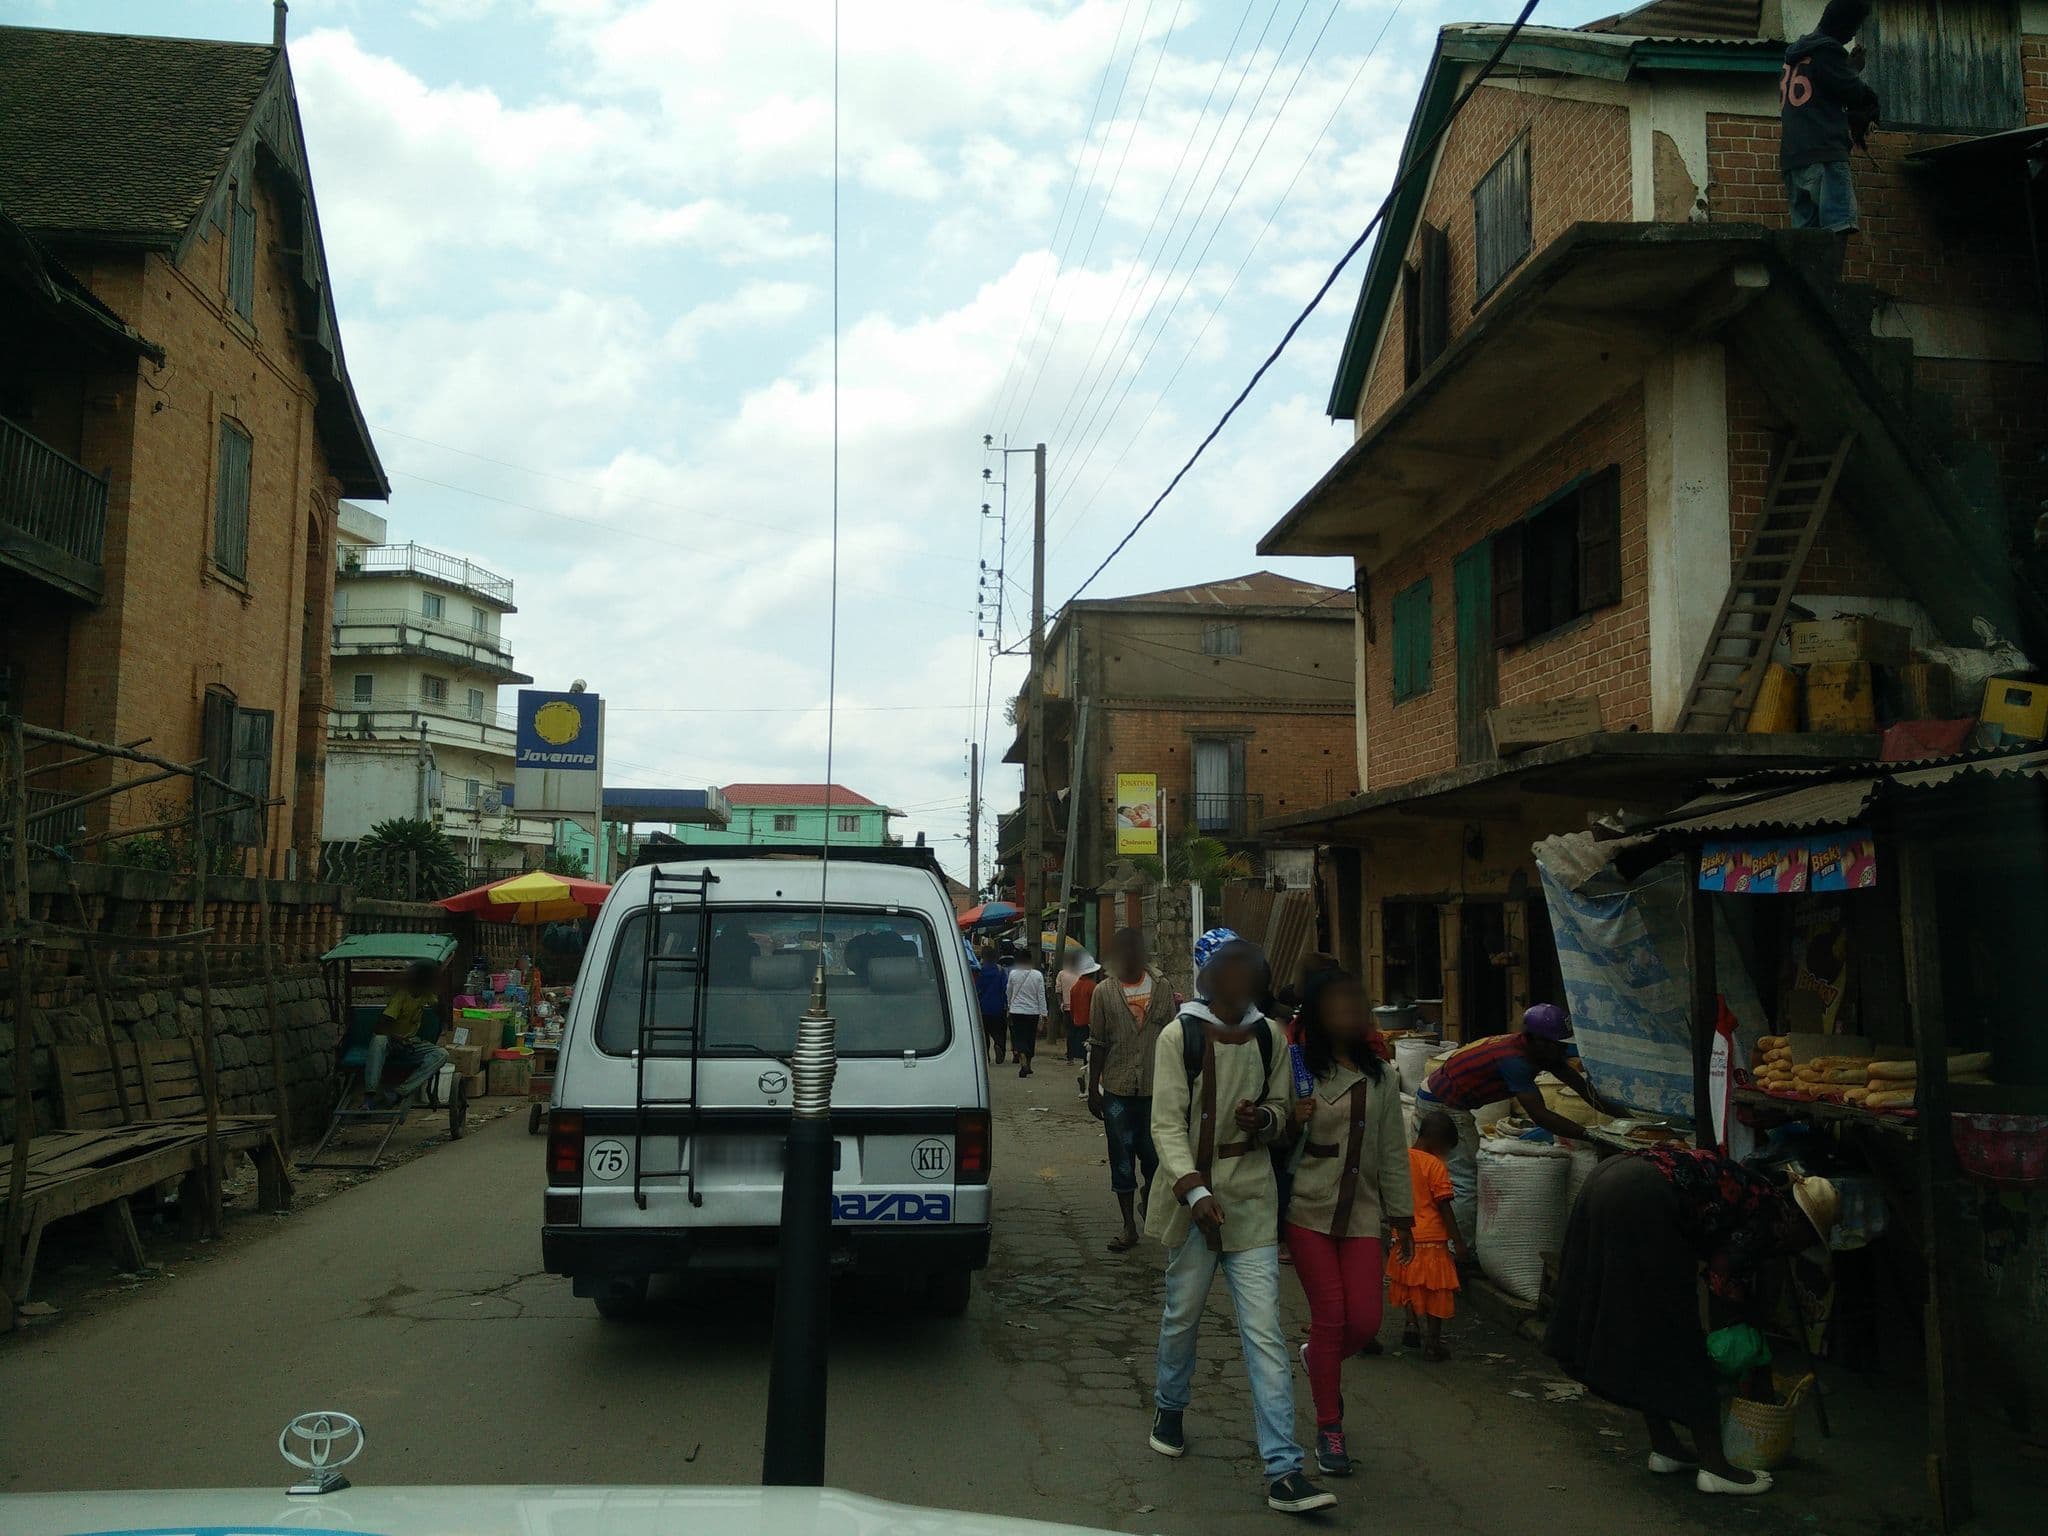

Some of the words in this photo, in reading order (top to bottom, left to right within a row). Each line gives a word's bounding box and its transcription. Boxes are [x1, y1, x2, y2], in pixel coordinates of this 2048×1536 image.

[518, 749, 596, 764] Jovenna
[594, 1149, 622, 1171] 75
[917, 1147, 944, 1170] KH
